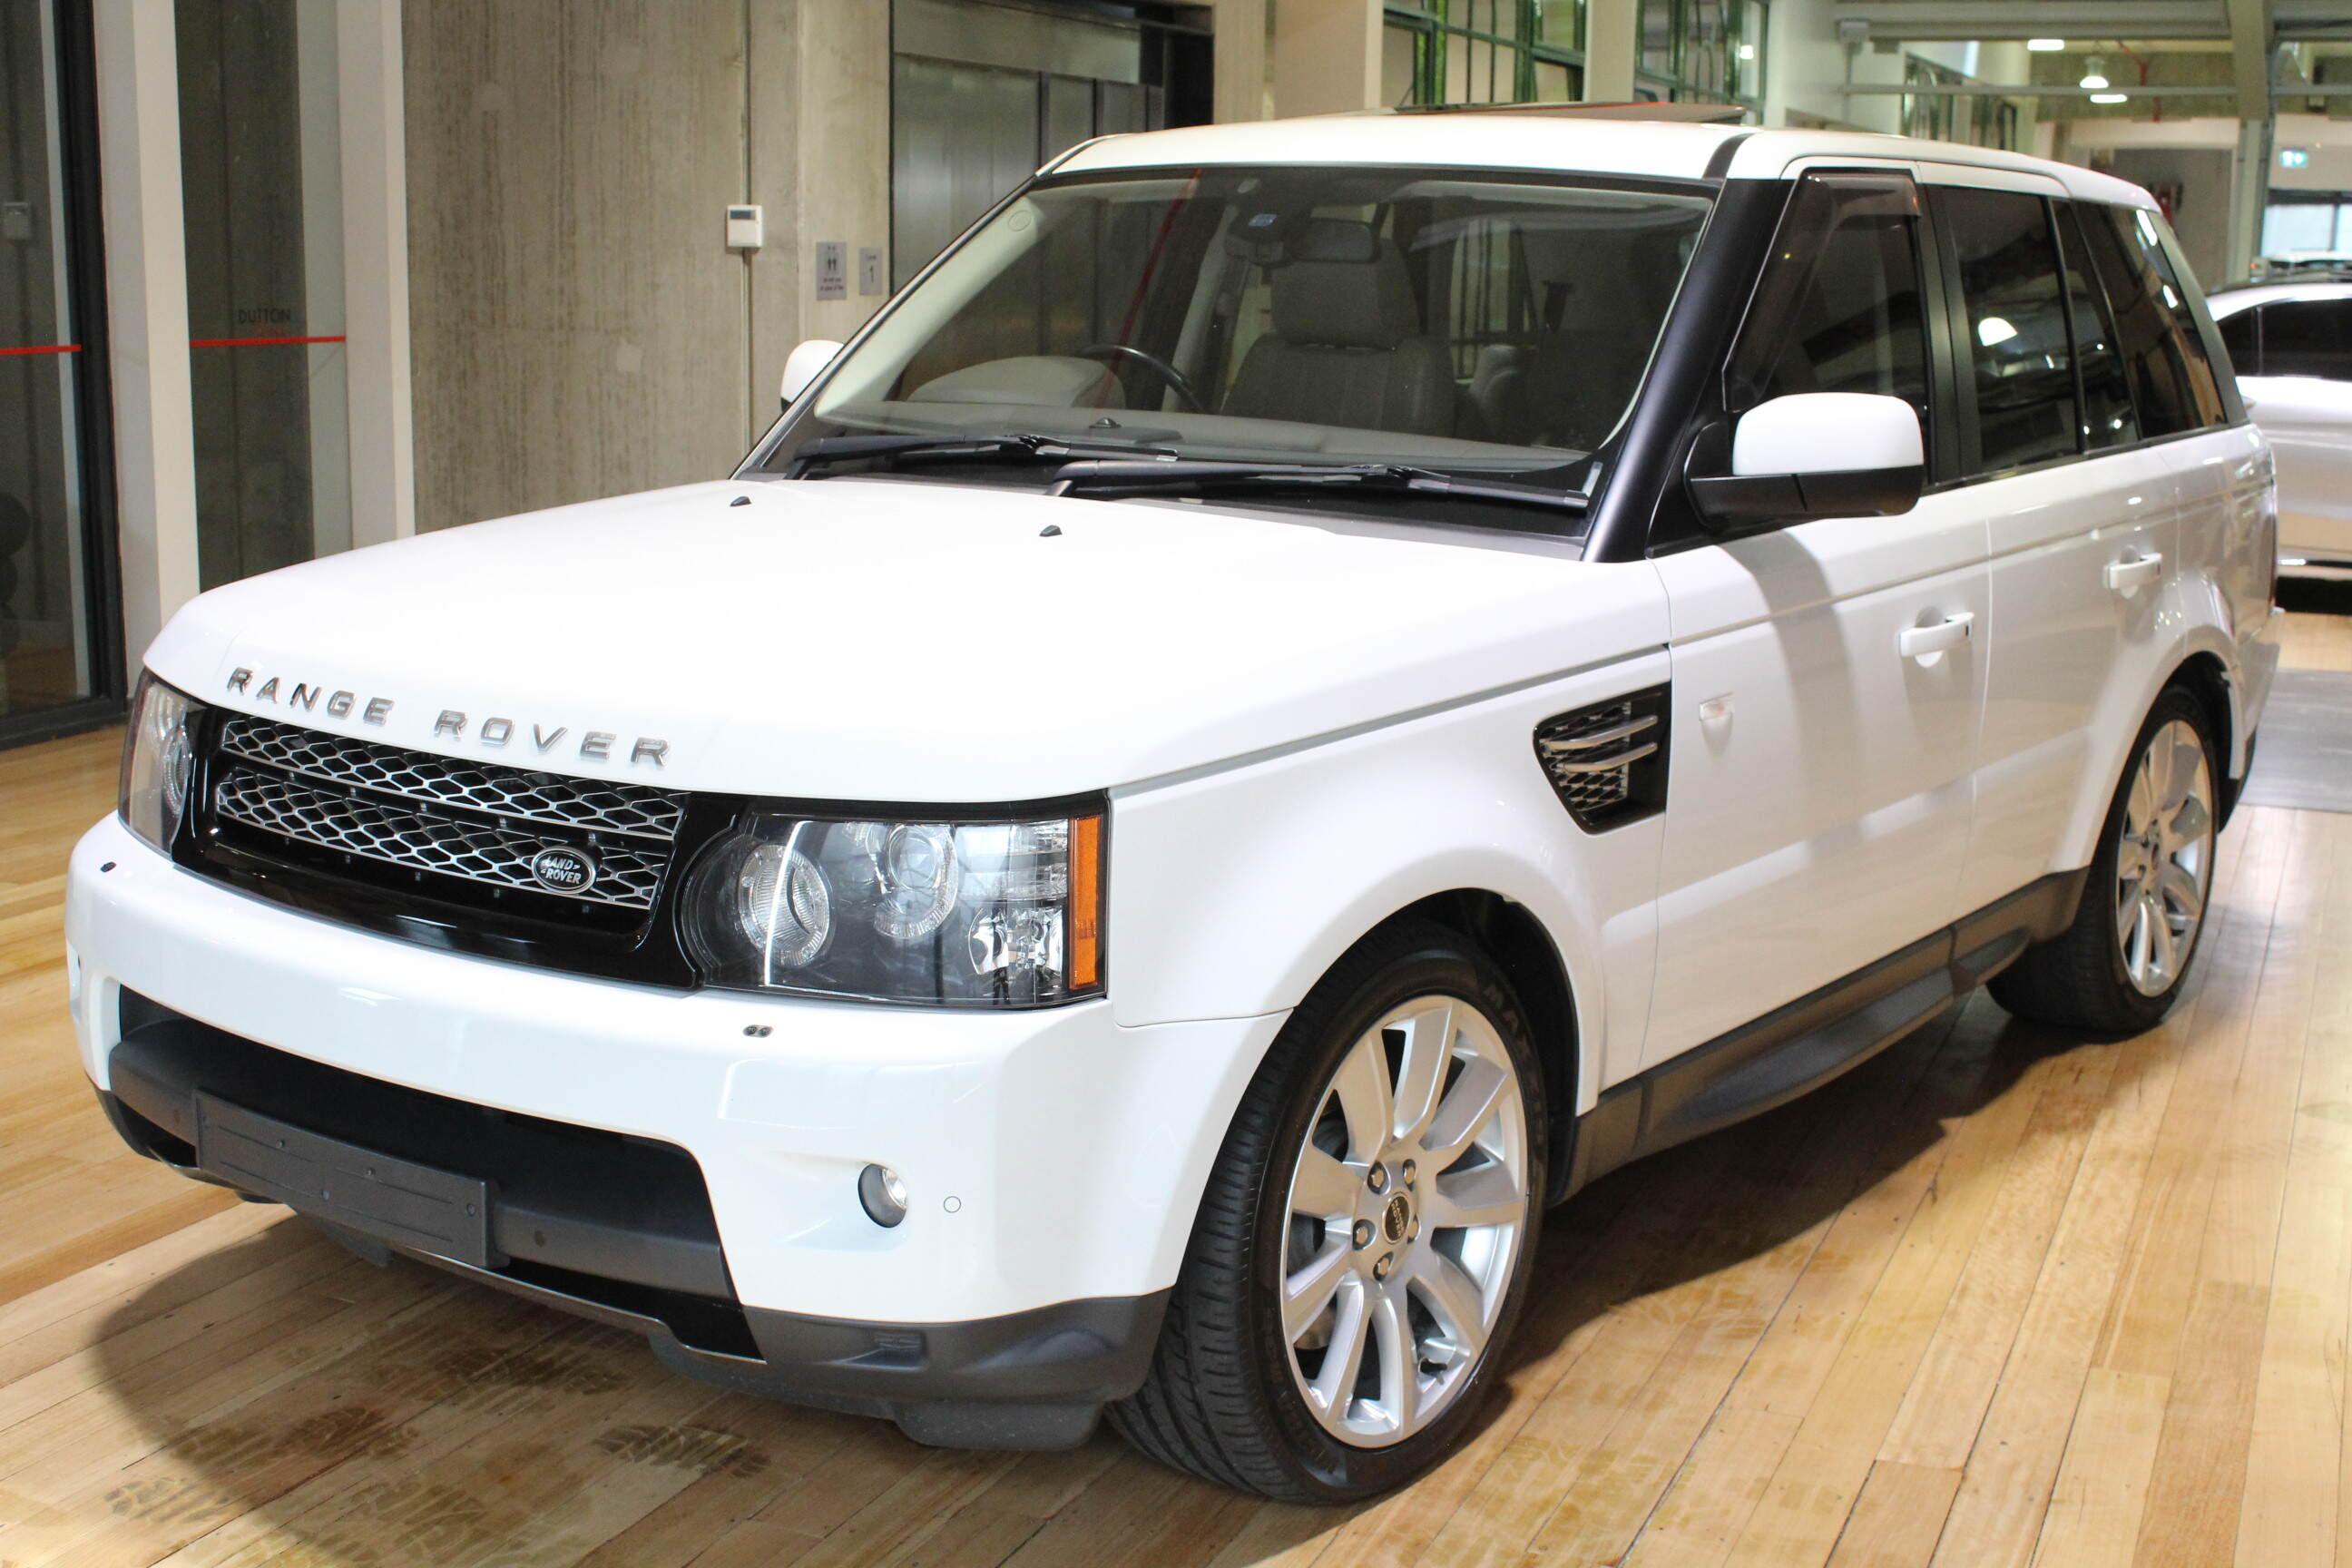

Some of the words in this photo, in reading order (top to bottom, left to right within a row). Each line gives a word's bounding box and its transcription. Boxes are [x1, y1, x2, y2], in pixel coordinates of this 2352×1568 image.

[227, 667, 395, 726] RANGE
[434, 710, 669, 767] ROVER
[545, 856, 574, 871] LAND
[545, 868, 582, 884] ROVER
